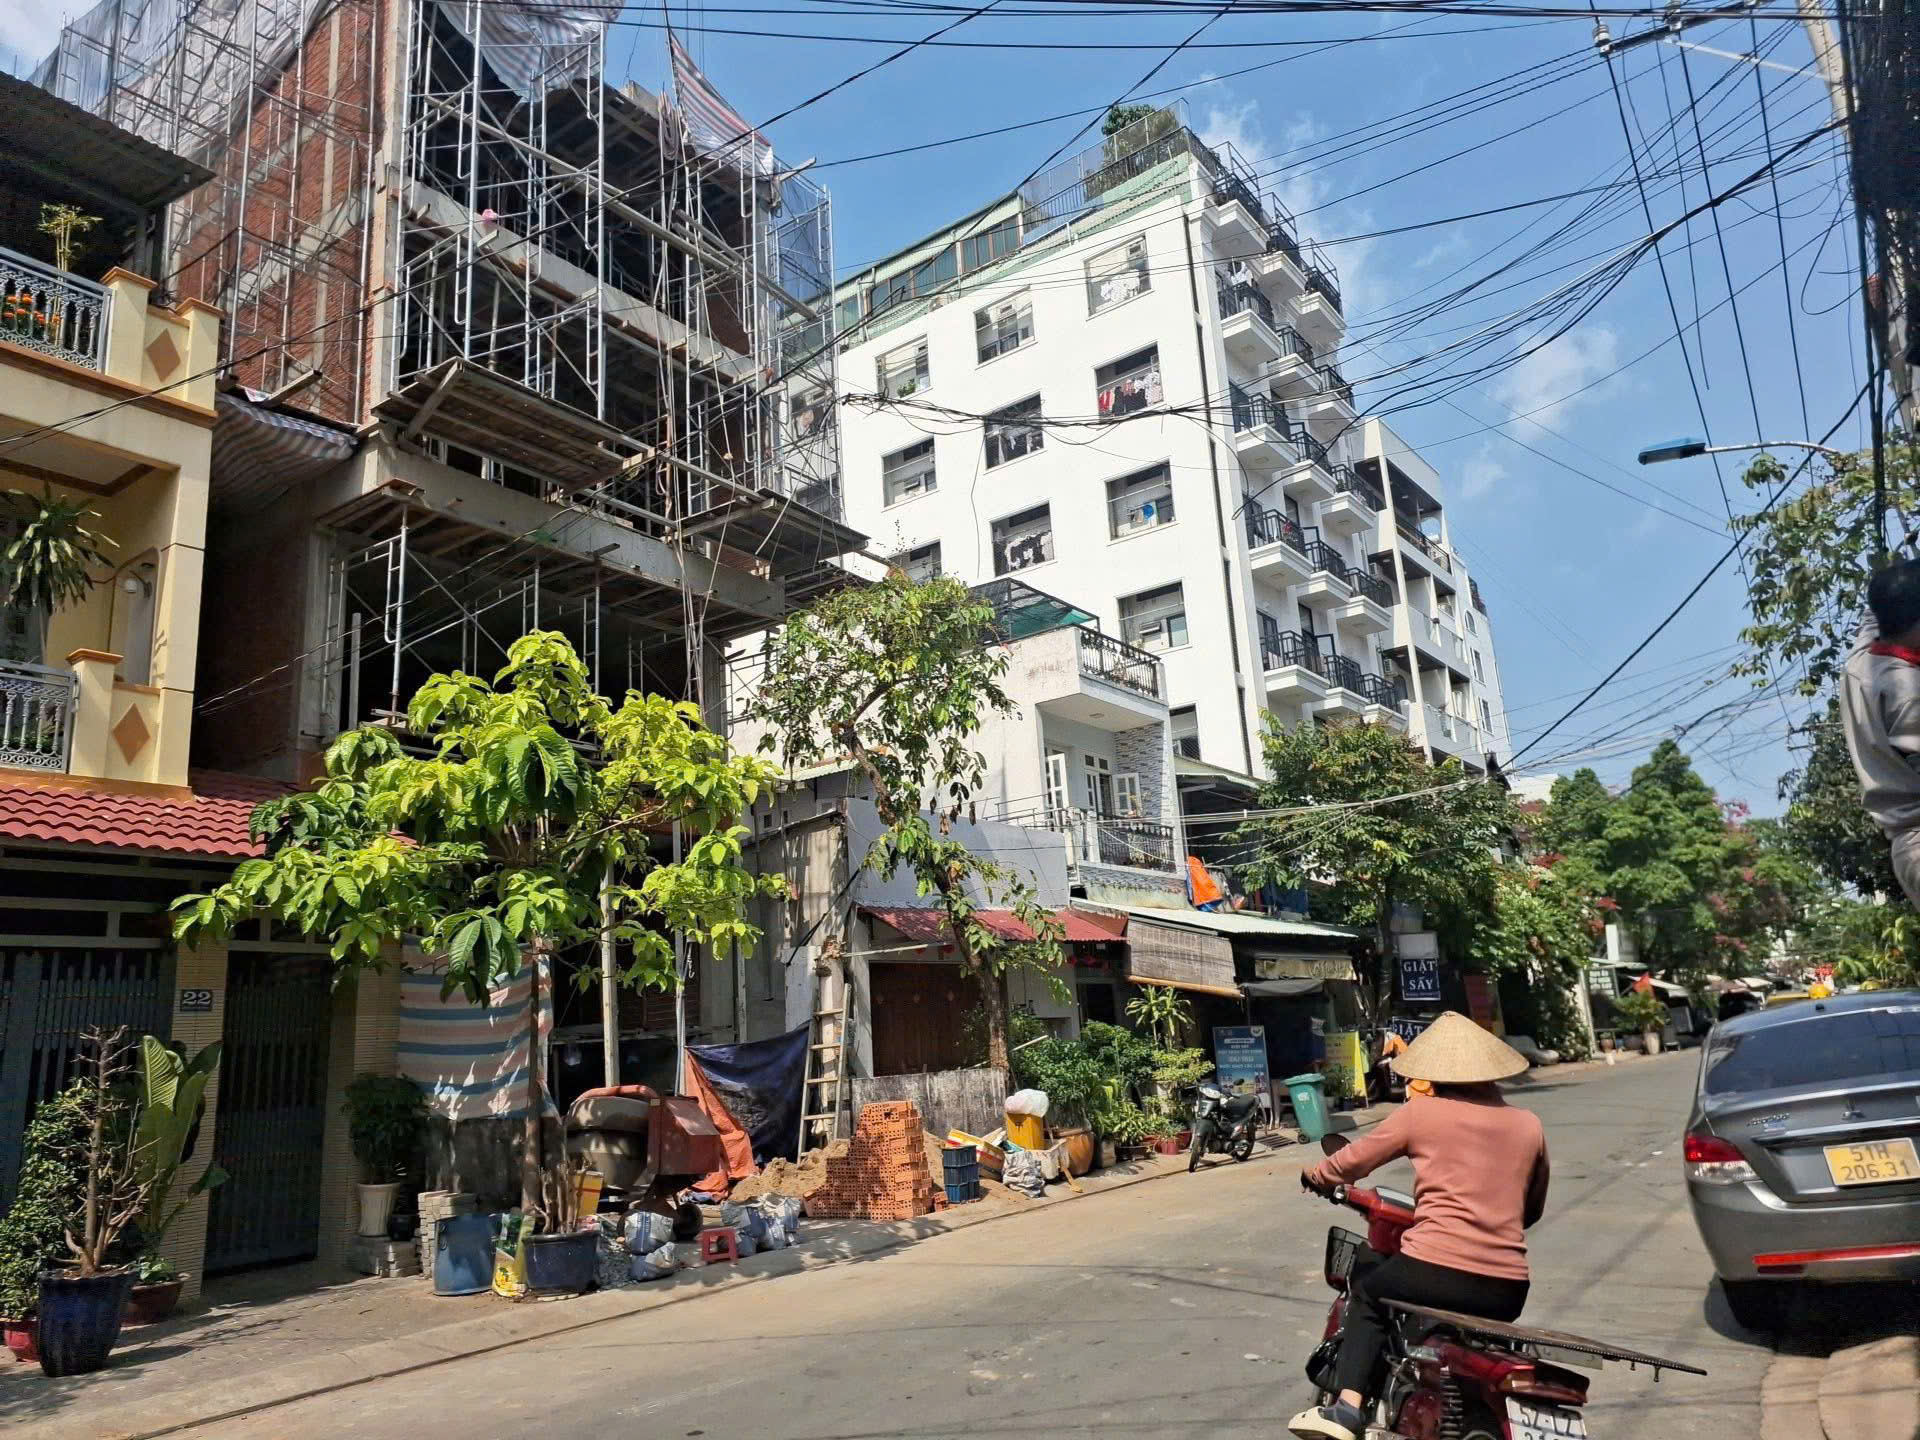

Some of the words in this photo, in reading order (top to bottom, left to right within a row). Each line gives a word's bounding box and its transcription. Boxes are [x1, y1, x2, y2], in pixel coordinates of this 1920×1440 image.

[1403, 959, 1435, 975] GIẶT
[1409, 976, 1433, 990] SẤY
[183, 991, 211, 1005] 22
[1840, 1157, 1910, 1181] 206.31
